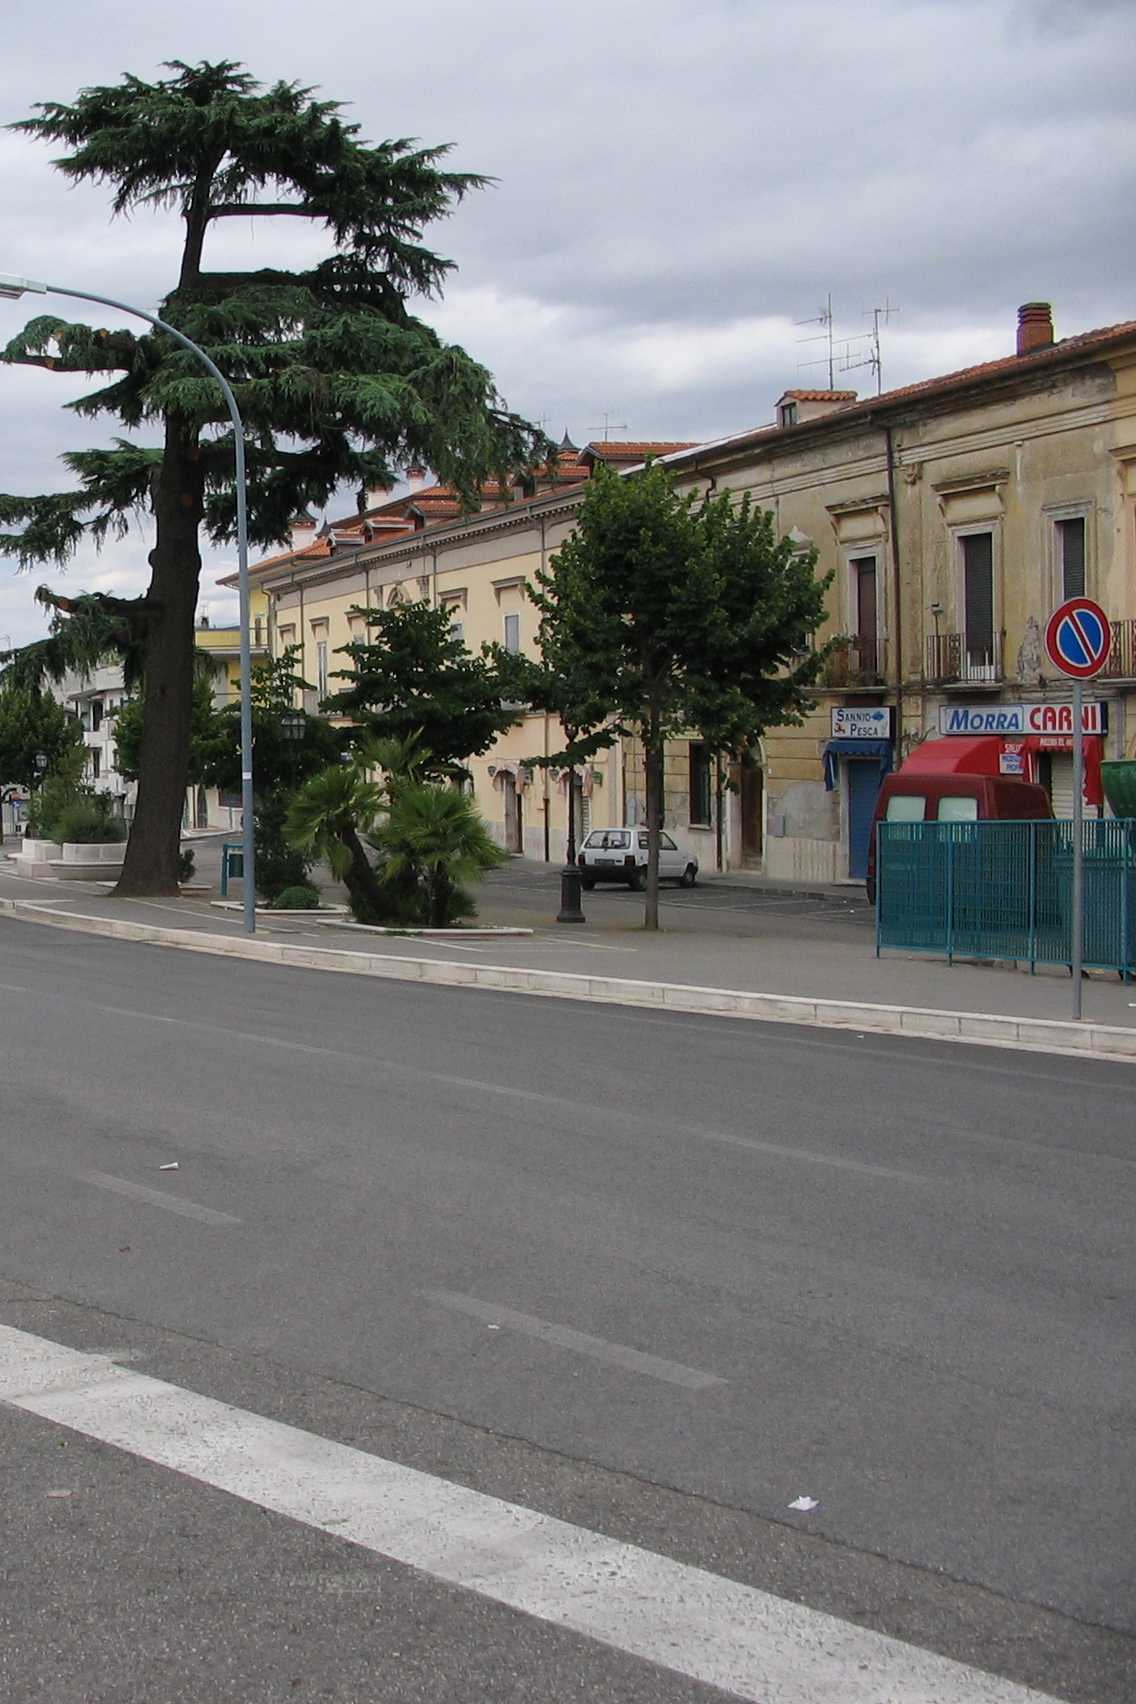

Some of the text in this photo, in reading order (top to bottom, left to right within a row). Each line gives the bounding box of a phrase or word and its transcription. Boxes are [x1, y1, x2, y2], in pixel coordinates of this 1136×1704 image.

[837, 709, 871, 722] SANNIO
[949, 709, 1019, 730] MORRA
[850, 723, 878, 736] PESCA
